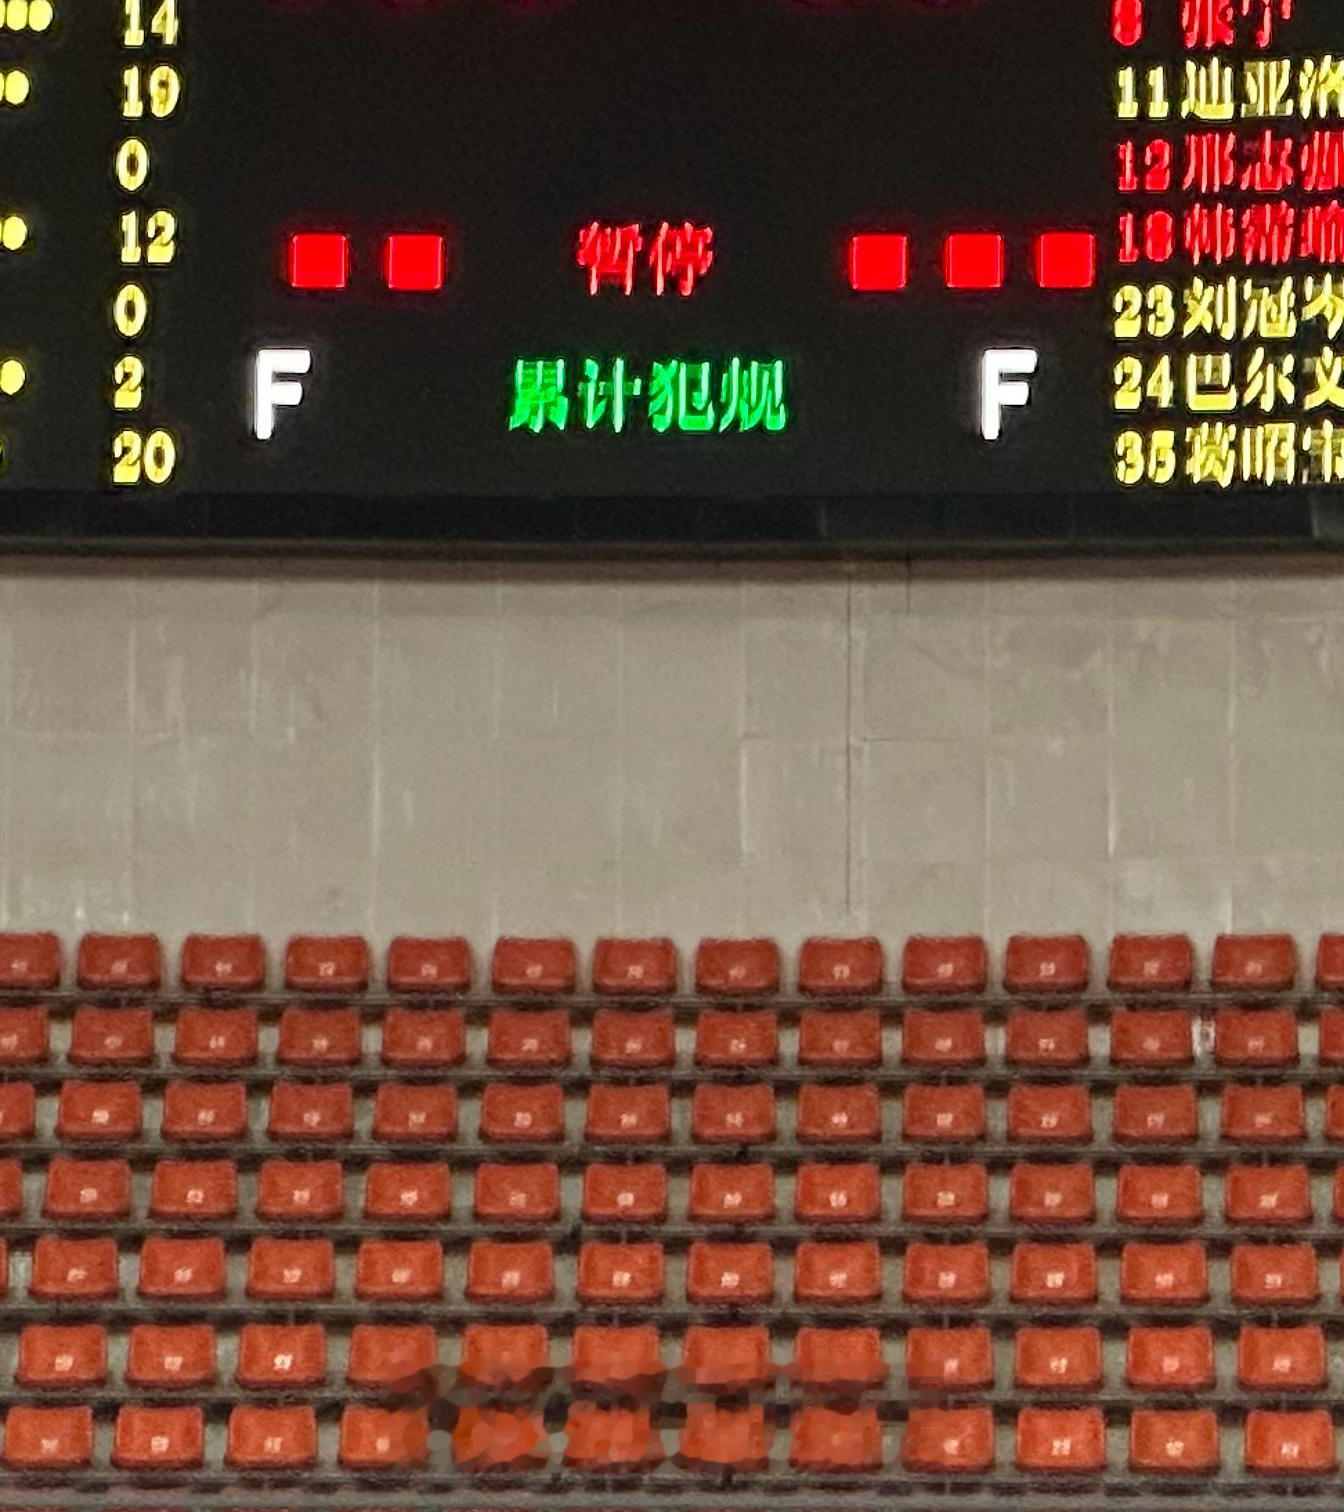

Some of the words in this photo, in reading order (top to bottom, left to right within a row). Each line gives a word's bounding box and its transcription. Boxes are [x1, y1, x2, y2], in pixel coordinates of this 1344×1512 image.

[123, 66, 180, 117] 19
[1118, 66, 1168, 120] 11
[116, 139, 149, 191] 0
[1118, 139, 1172, 193] 12
[121, 211, 175, 262] 12
[577, 222, 713, 296] 暂停
[114, 285, 146, 336] 0
[1114, 284, 1174, 337] 23
[114, 356, 144, 408] 2
[254, 350, 310, 439] F
[509, 357, 786, 433] 累计犯规
[979, 350, 1037, 439] F
[1114, 355, 1174, 409] 24
[114, 431, 175, 483] 20
[1116, 430, 1175, 484] 35
